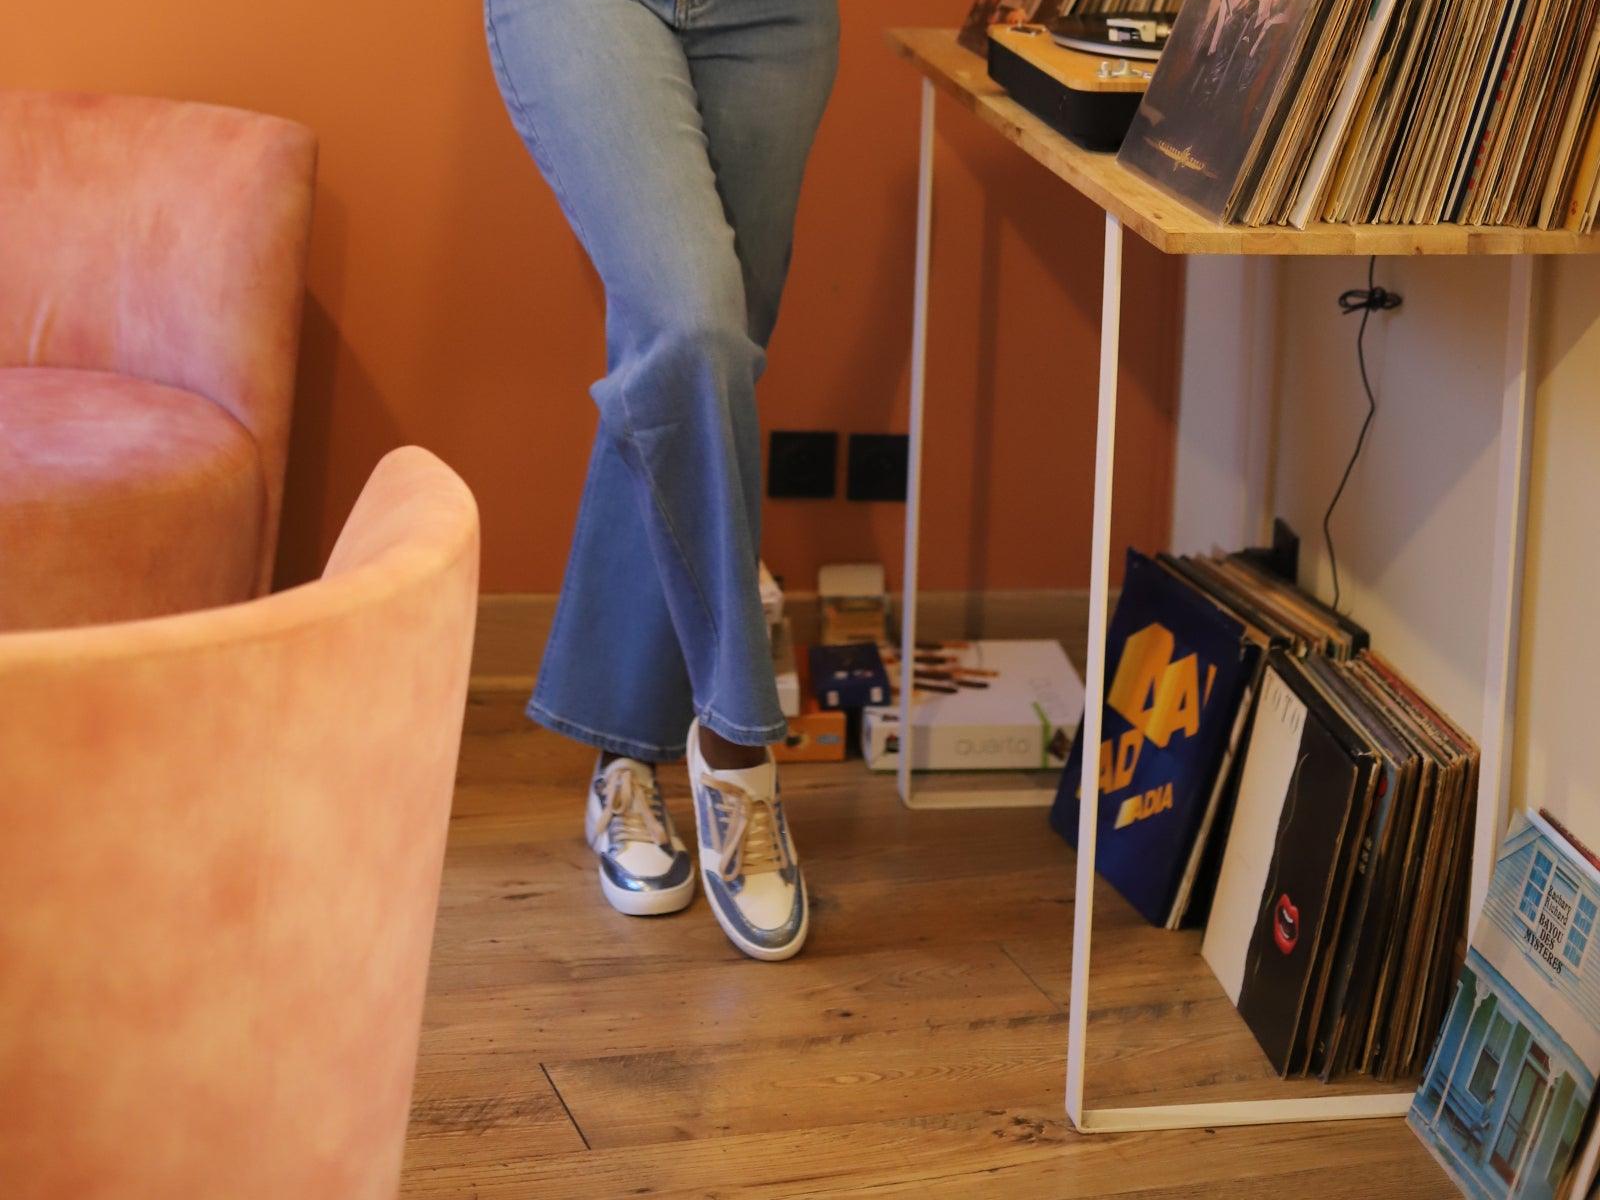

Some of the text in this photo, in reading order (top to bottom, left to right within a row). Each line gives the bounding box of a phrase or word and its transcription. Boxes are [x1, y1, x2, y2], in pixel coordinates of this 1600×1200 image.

[1544, 897, 1569, 926] Richard
[1546, 884, 1572, 917] Zachary
[1538, 913, 1564, 944] BAYOU
[1539, 929, 1555, 951] DES
[1524, 928, 1563, 974] MYSTERES
